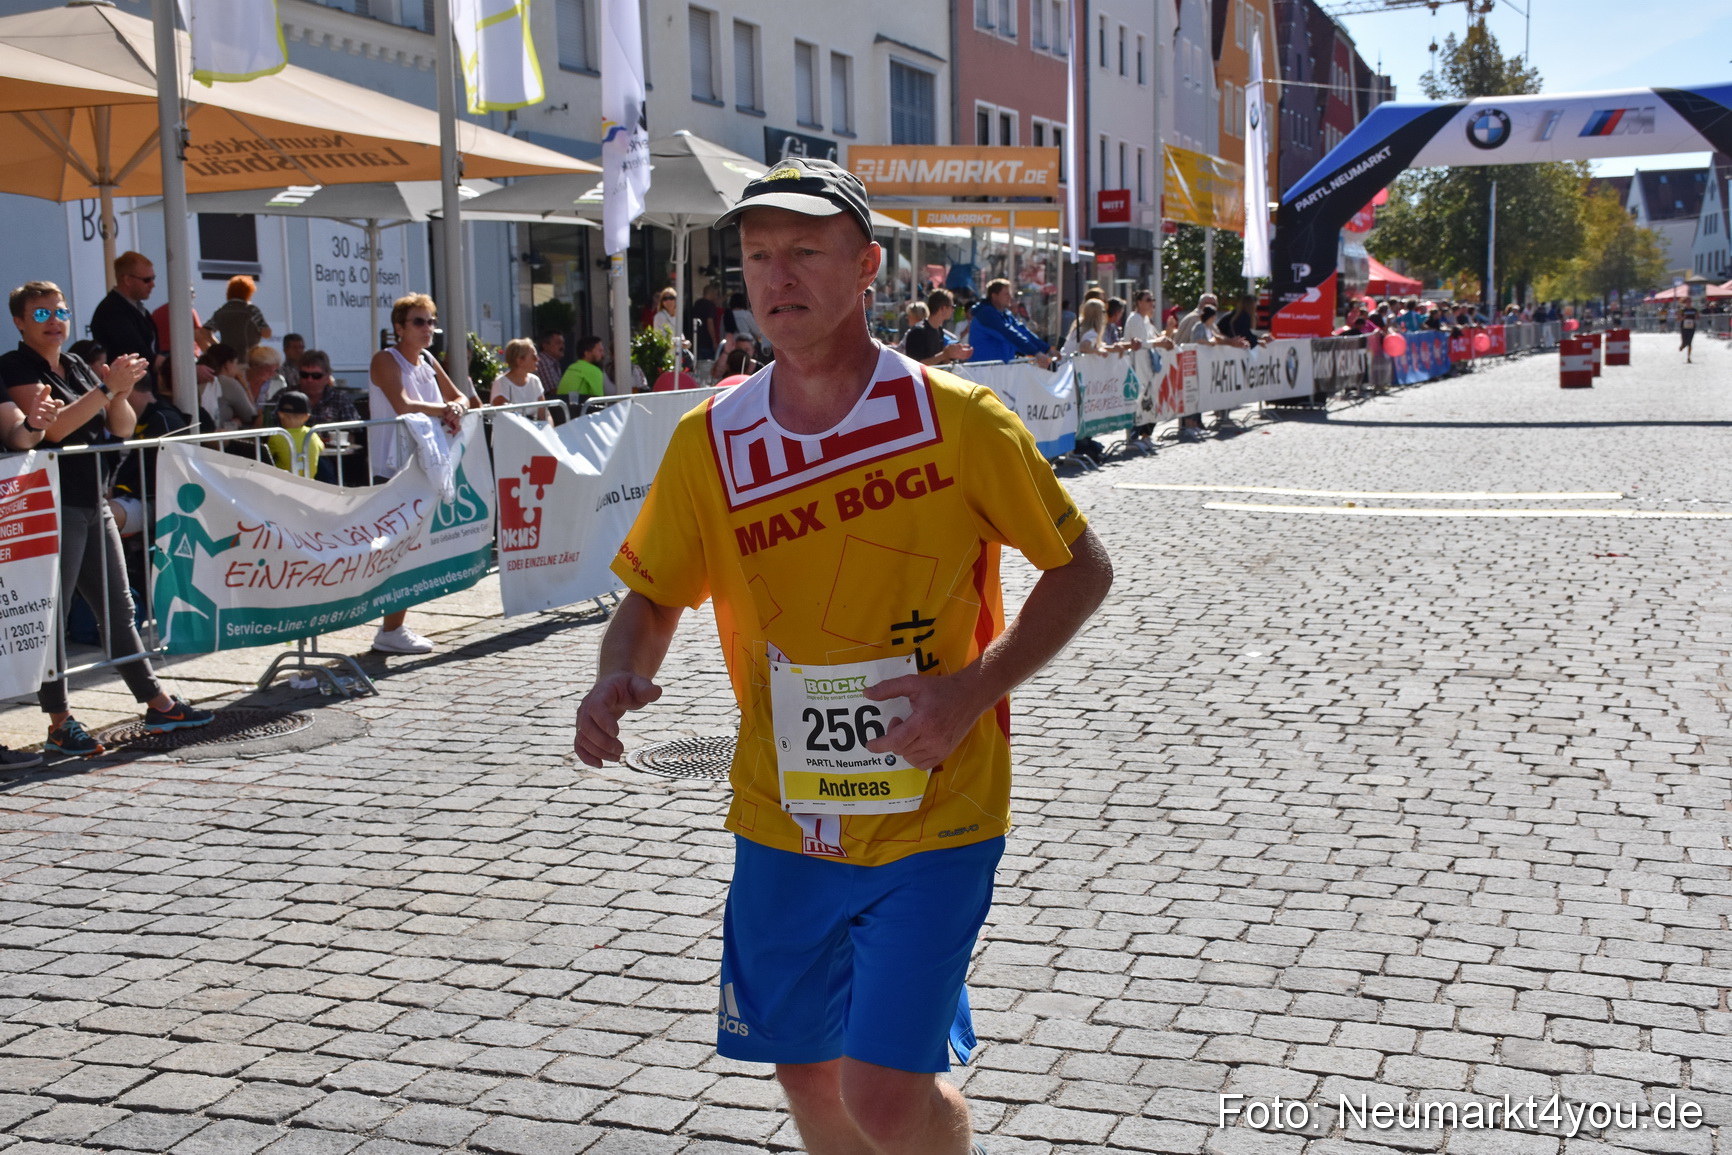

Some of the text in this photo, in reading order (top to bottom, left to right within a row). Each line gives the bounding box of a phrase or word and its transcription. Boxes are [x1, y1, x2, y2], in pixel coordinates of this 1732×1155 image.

[855, 158, 1048, 184] RUNMARKT.DE
[1295, 146, 1392, 212] PARTL NEUMARKT
[1102, 200, 1125, 209] WITT
[332, 236, 384, 260] 30 Jahe
[315, 264, 400, 287] Bang & Ofsen
[326, 289, 393, 308] in Neumrkt
[734, 462, 955, 557] MAX BÖGL
[502, 525, 538, 550] DKMS
[525, 554, 557, 569] EINZELNE
[558, 551, 580, 565] ZÄHLT
[11, 589, 18, 601] 8
[11, 620, 45, 638] 2307-0
[226, 619, 307, 637] Service-Line:
[804, 676, 867, 694] BOCK
[802, 704, 886, 752] 256
[806, 757, 882, 768] PARTL Neumarkt
[818, 777, 891, 798] Andreas
